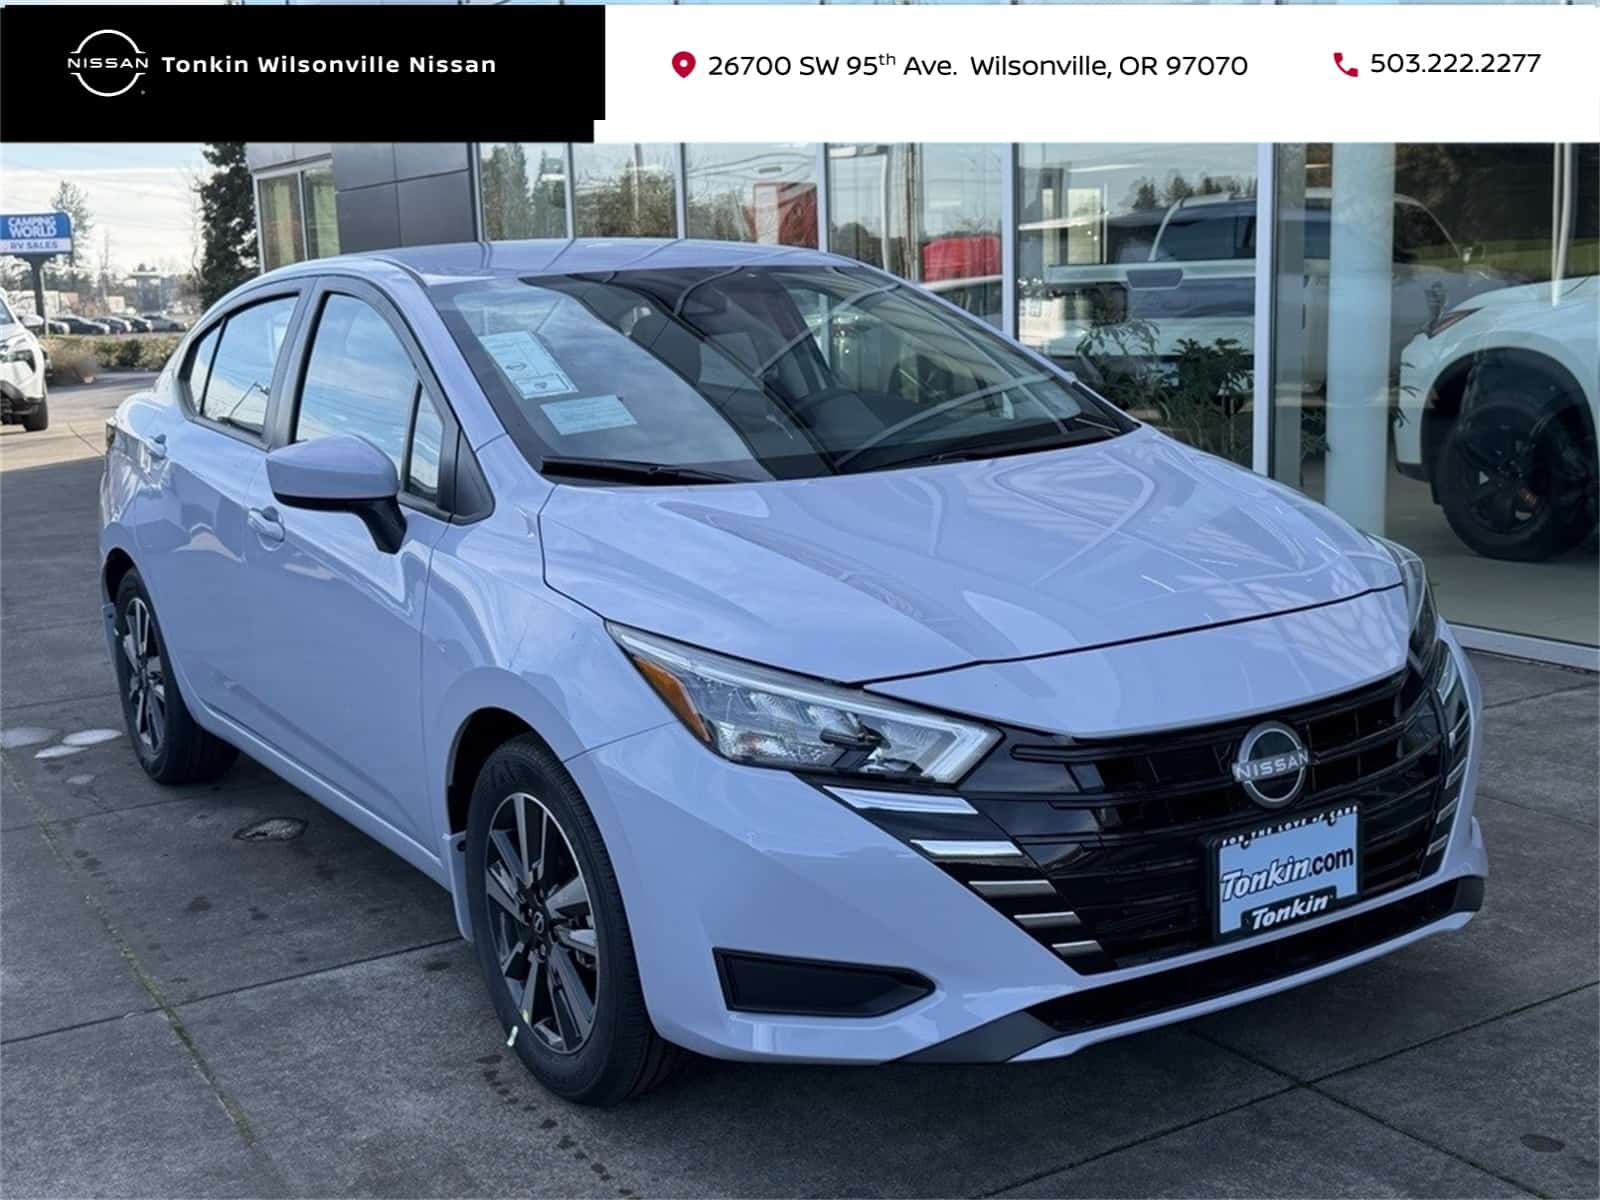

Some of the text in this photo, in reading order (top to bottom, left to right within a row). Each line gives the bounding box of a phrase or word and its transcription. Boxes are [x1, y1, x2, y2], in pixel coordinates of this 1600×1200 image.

[8, 216, 56, 227] CAMPING
[9, 226, 57, 238] WORLD
[27, 240, 58, 249] SALES
[1235, 751, 1309, 779] NISSAN
[1221, 847, 1354, 901] Tonkin.com
[1251, 896, 1329, 930] Tonkin
